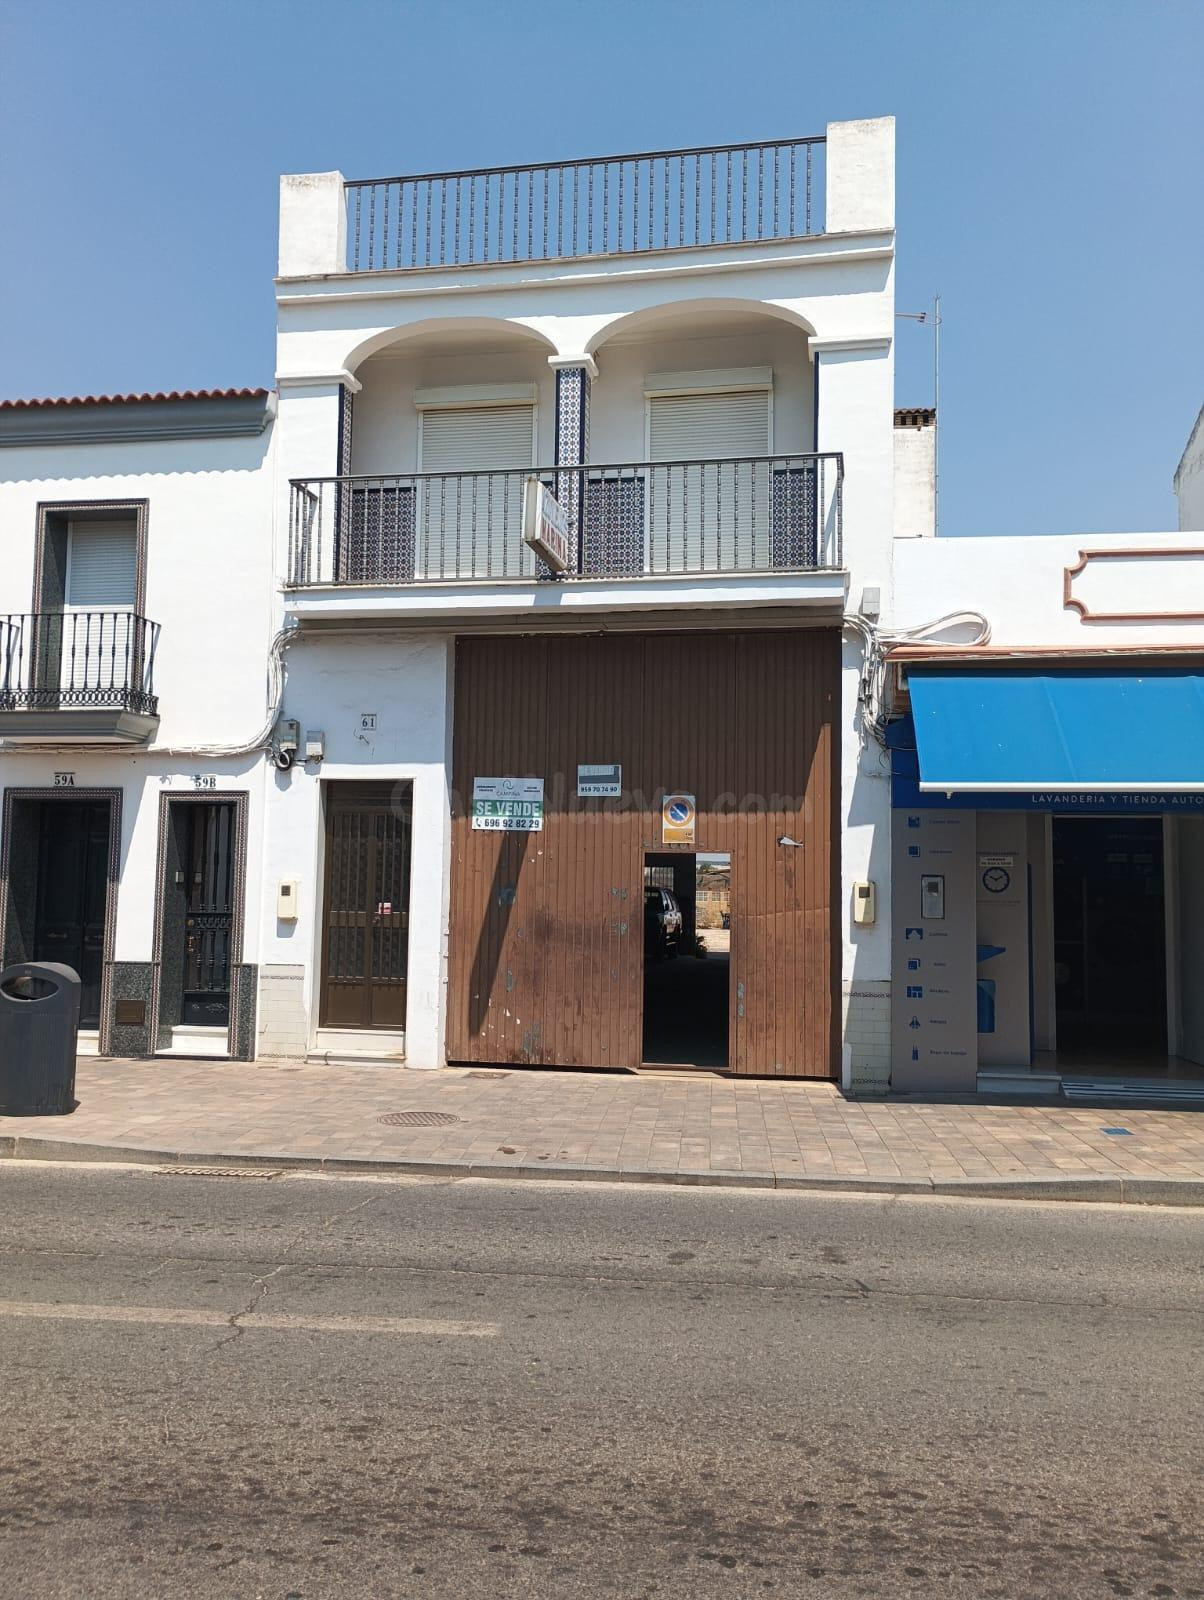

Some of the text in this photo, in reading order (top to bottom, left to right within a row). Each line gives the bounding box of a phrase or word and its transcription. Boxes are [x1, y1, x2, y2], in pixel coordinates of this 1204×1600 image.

[362, 717, 375, 728] 61
[54, 774, 75, 786] 59A
[195, 777, 217, 788] 59B
[1031, 794, 1204, 805] LAVANDERIA Y TIENDA AUTO
[476, 801, 540, 816] SE VENDE
[484, 818, 540, 829] 696 92 82 29
